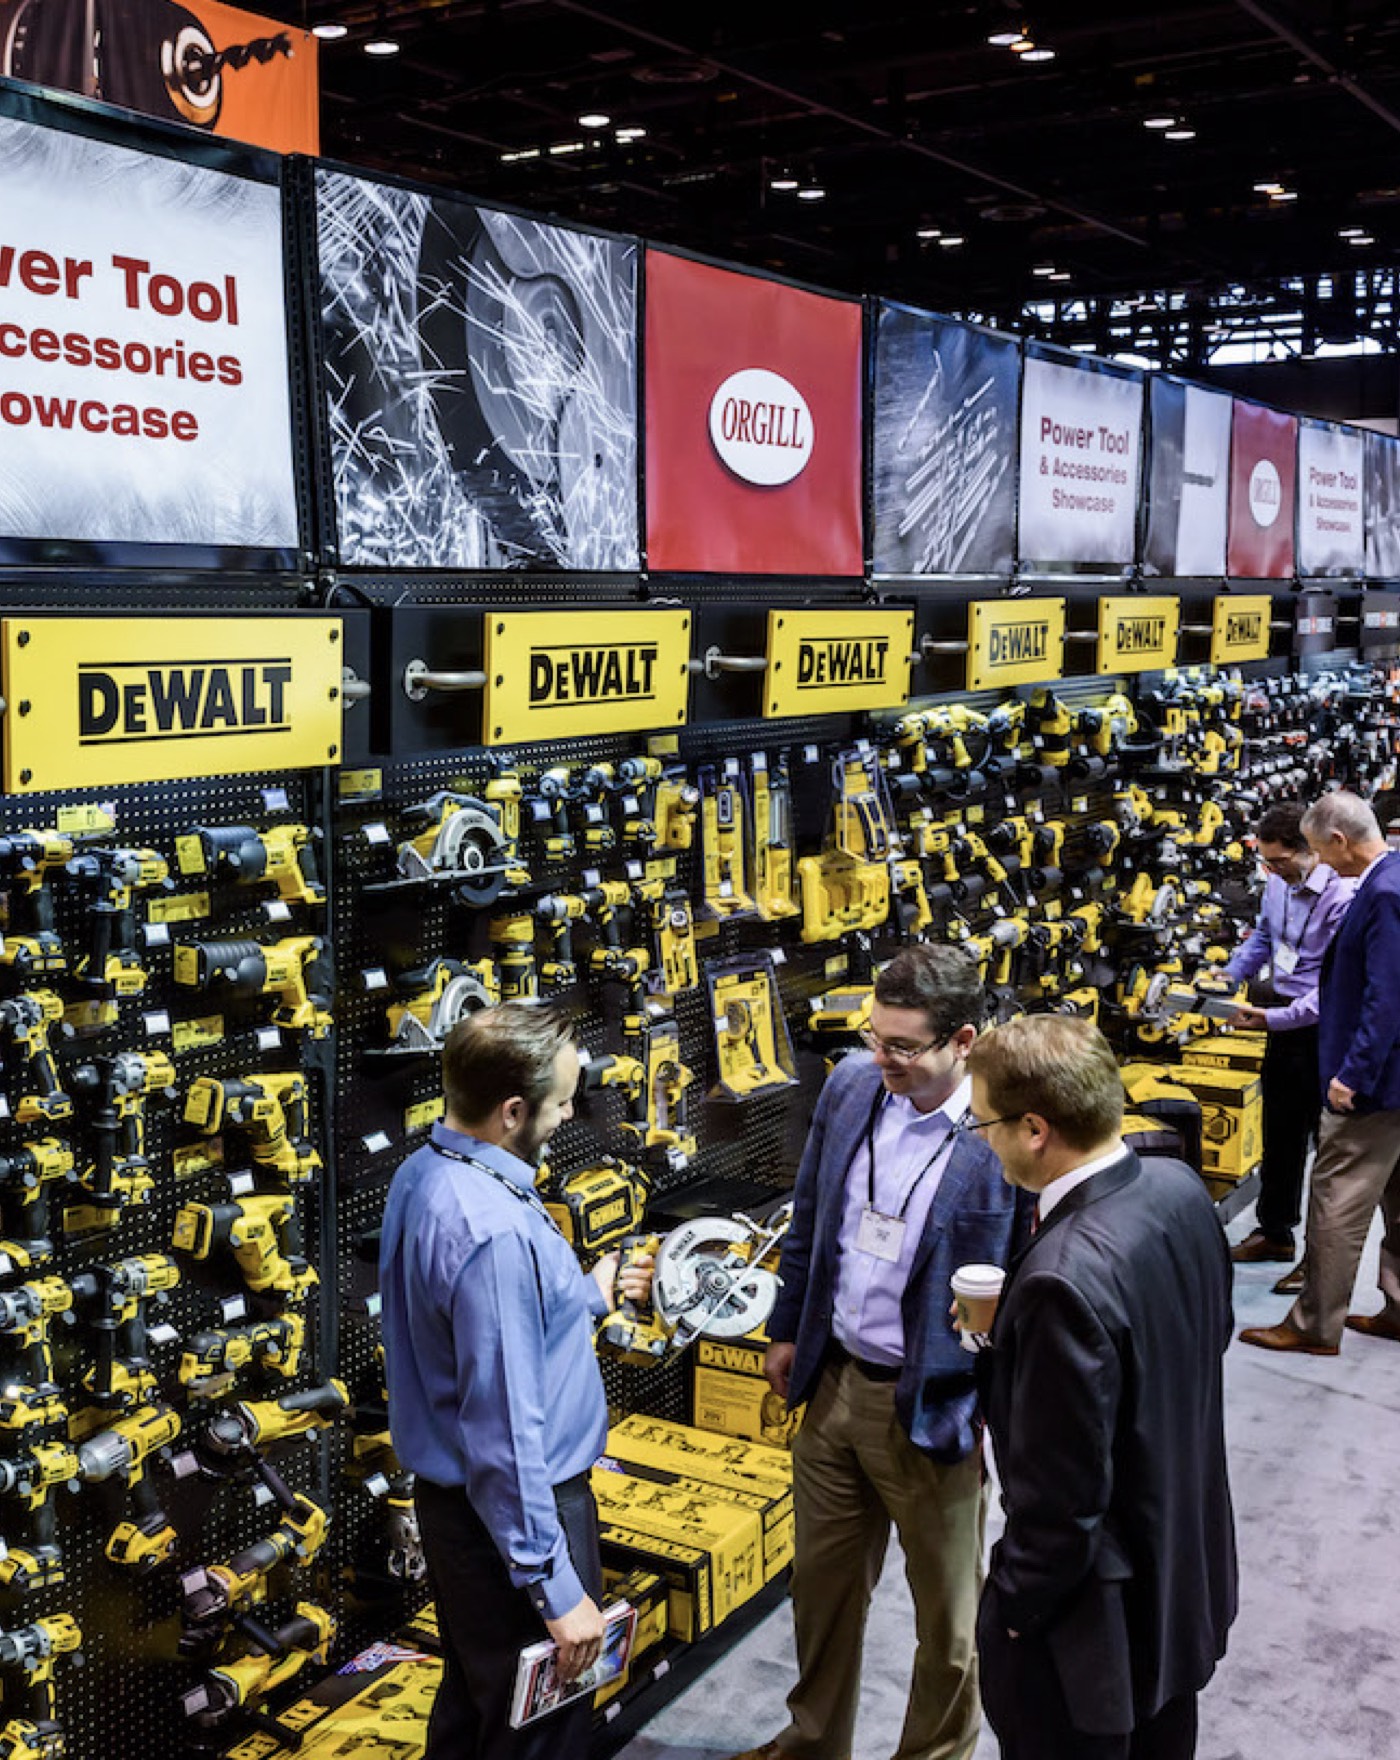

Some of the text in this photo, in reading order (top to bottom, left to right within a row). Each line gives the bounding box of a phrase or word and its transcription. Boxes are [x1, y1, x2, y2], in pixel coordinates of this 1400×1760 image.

[112, 255, 239, 326] Tool
[0, 323, 243, 386] cessories
[0, 391, 199, 442] owcase
[722, 397, 805, 449] ORGILL
[1041, 416, 1129, 455] Power Tool
[1040, 455, 1127, 485] & Accessories
[1310, 466, 1357, 491] Power Tool
[1053, 488, 1115, 514] Showcase
[989, 616, 1048, 661] DEWALT
[1116, 620, 1166, 649] DEWALT
[529, 648, 658, 702] DEWALT
[797, 642, 889, 683] DEWALT
[78, 666, 292, 737] DEWALT
